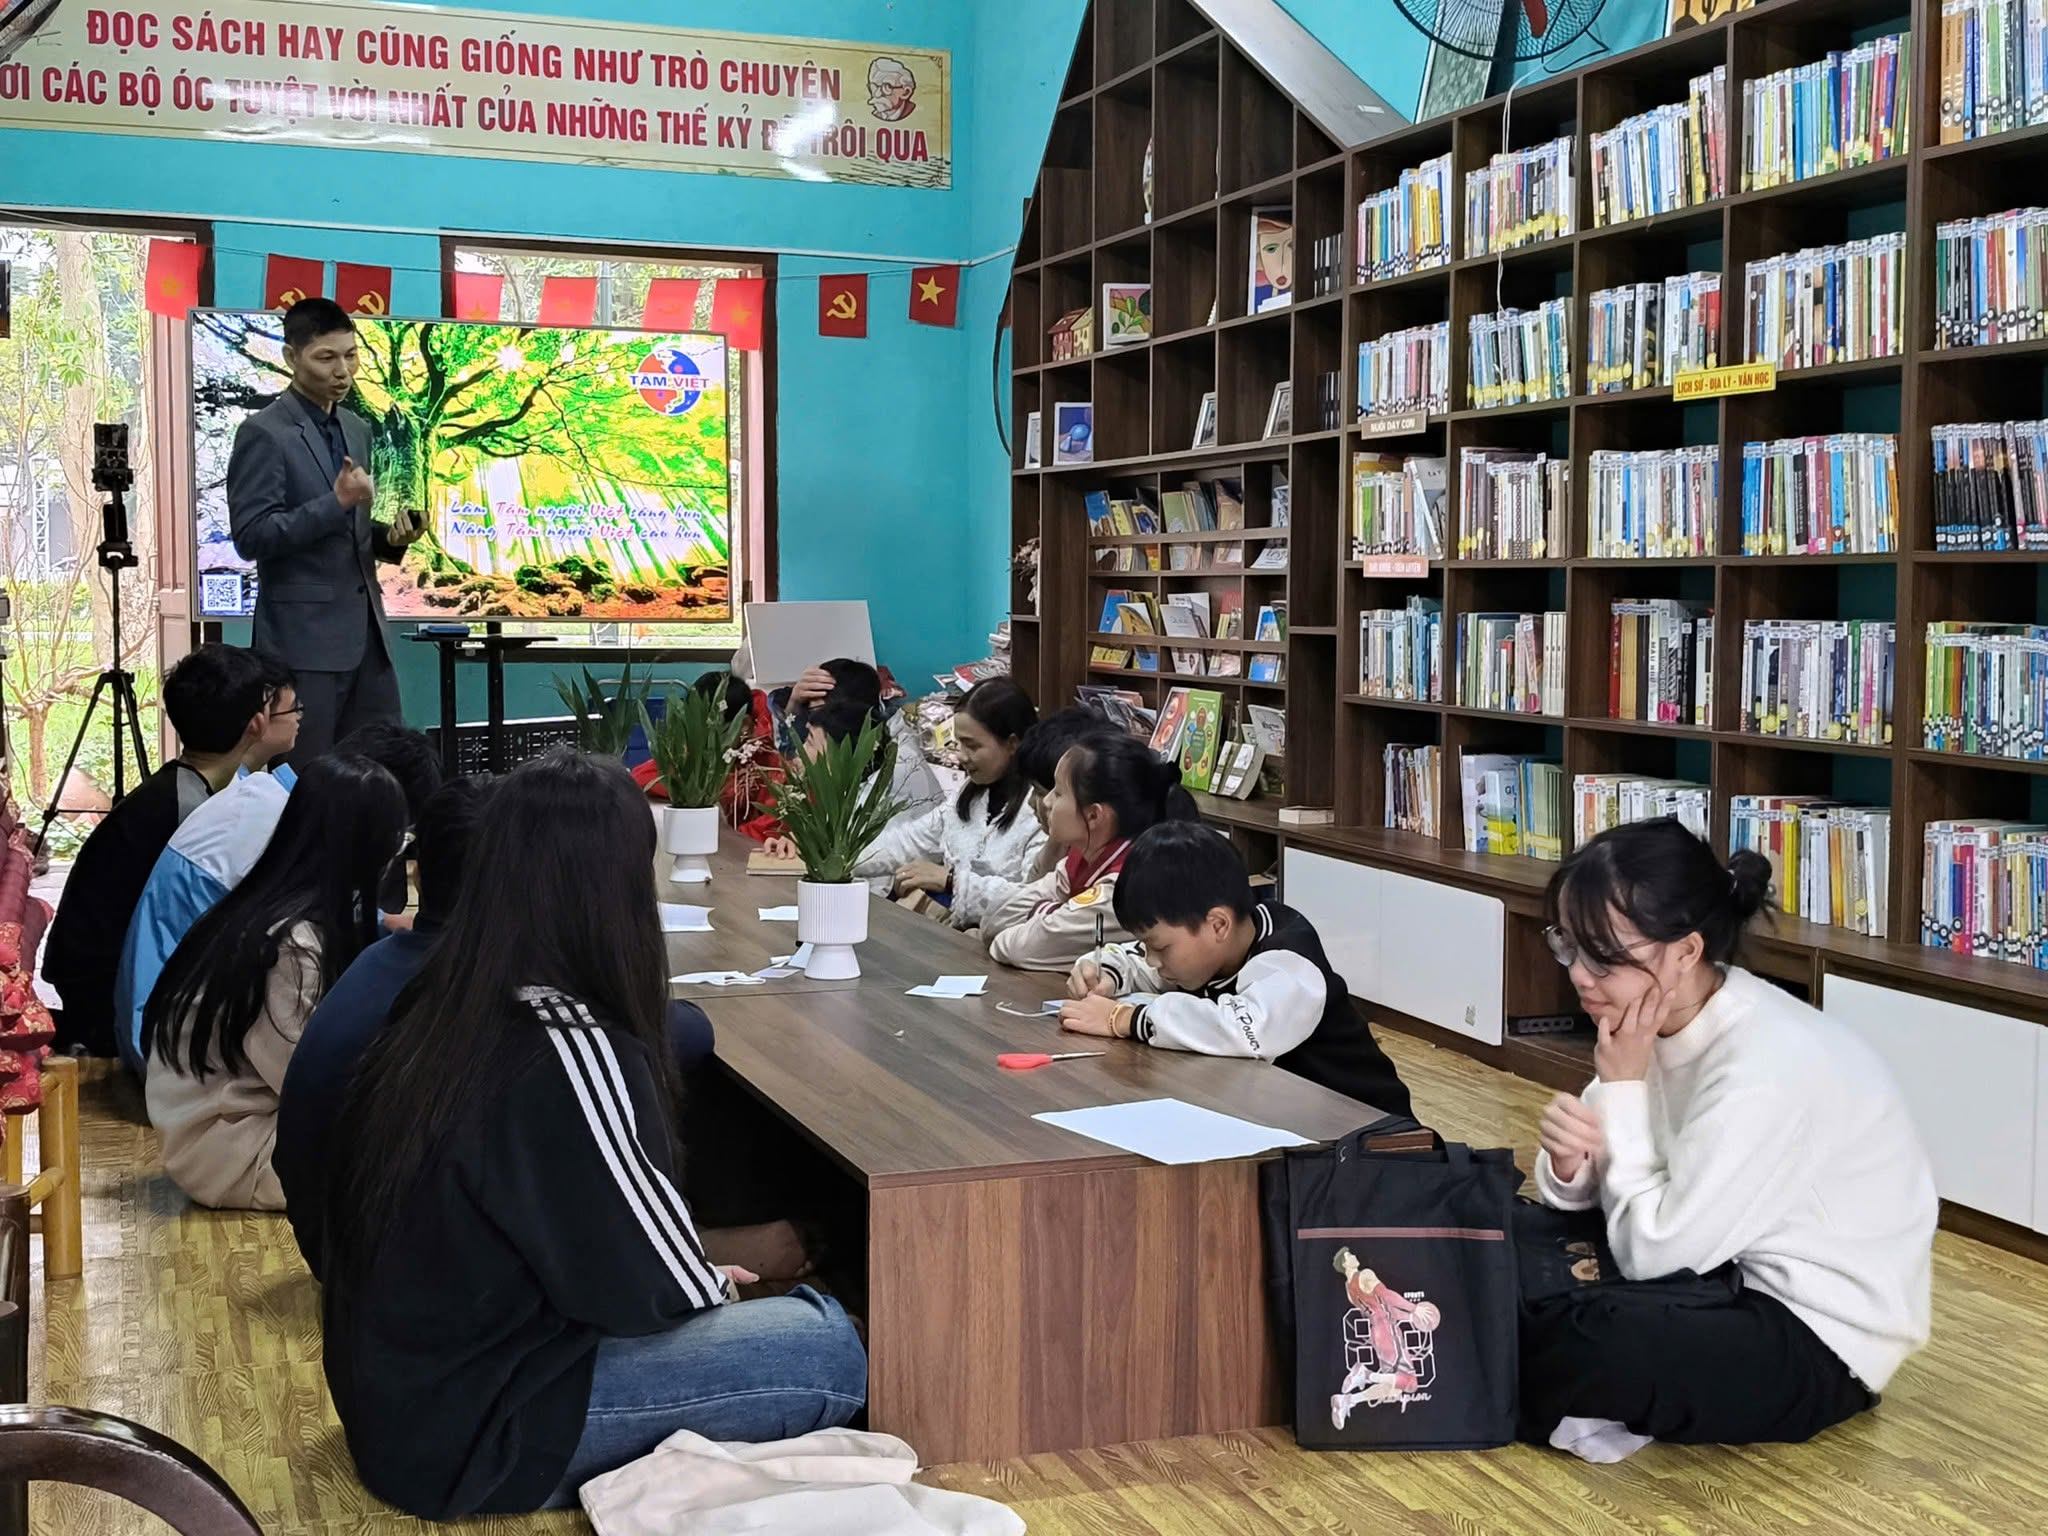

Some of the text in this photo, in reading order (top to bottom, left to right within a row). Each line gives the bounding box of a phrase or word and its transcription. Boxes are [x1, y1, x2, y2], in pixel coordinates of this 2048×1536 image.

[87, 9, 841, 107] ĐỌC SÁCH HAY CŨNG GIỐNG NHƯ TRÒ CHUYỆN
[42, 61, 108, 105] CÁC
[119, 67, 161, 116] BỘ
[173, 68, 214, 112] ÓC
[225, 76, 319, 124] TUYỆT
[328, 78, 378, 122] VỜI
[389, 82, 468, 129] NHẤT
[478, 84, 537, 132] CỦA
[547, 98, 647, 142] NHỮNG
[658, 103, 707, 147] THẾ
[718, 104, 751, 150] KỶ
[876, 127, 928, 162] QUA
